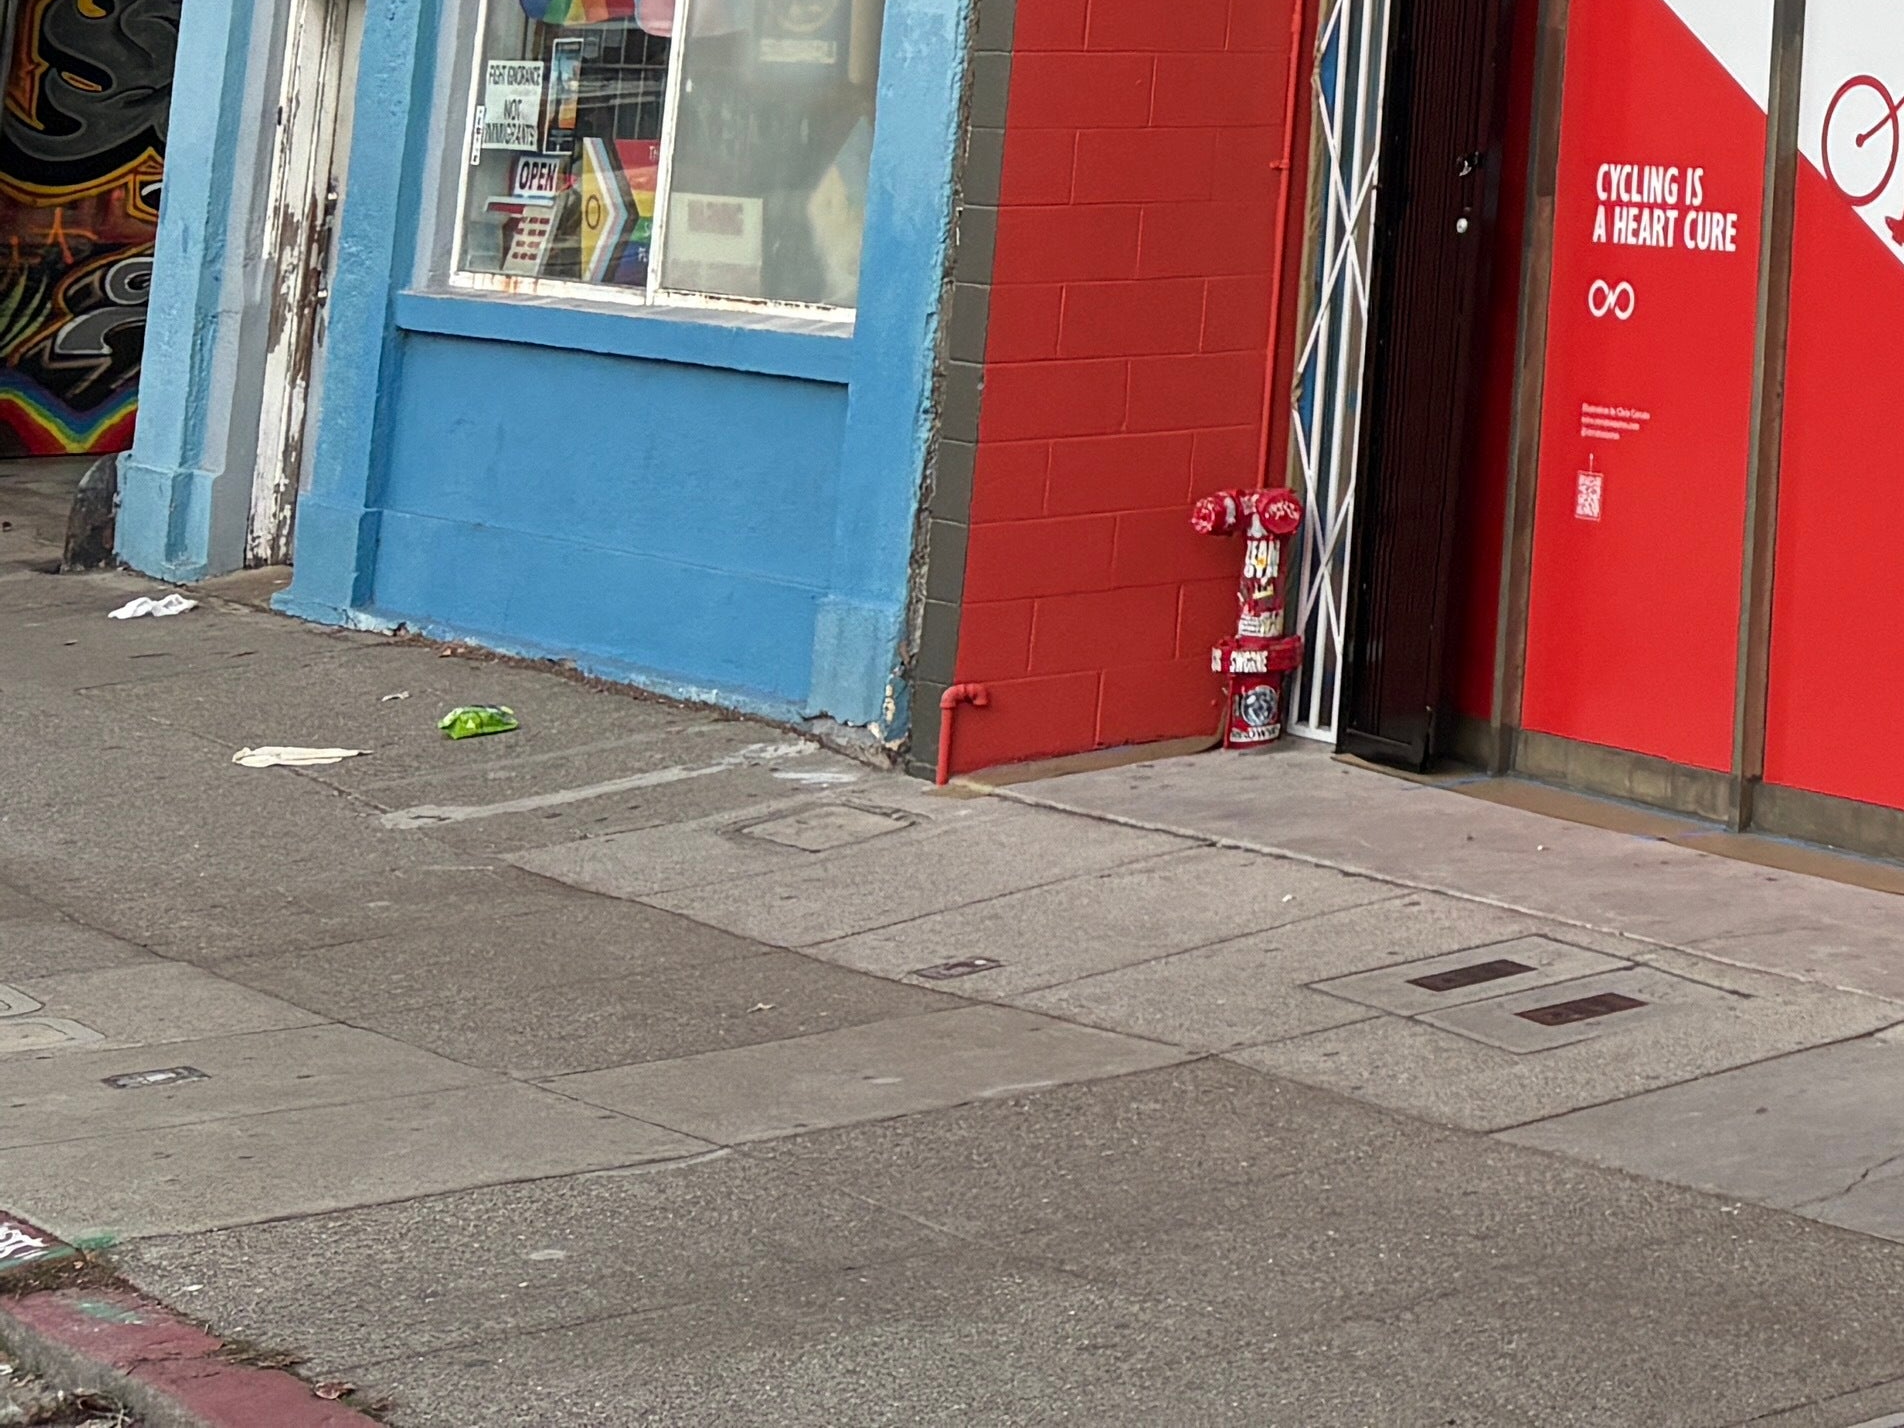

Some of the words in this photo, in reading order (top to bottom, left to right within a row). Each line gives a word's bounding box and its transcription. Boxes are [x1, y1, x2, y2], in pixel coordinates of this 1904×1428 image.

[504, 99, 522, 120] NOT
[519, 159, 556, 192] OPEN
[1596, 162, 1679, 206] CYCLING
[1685, 167, 1704, 207] IS
[1592, 204, 1607, 243] A
[1613, 206, 1679, 247] HEART
[1683, 210, 1738, 252] CURE
